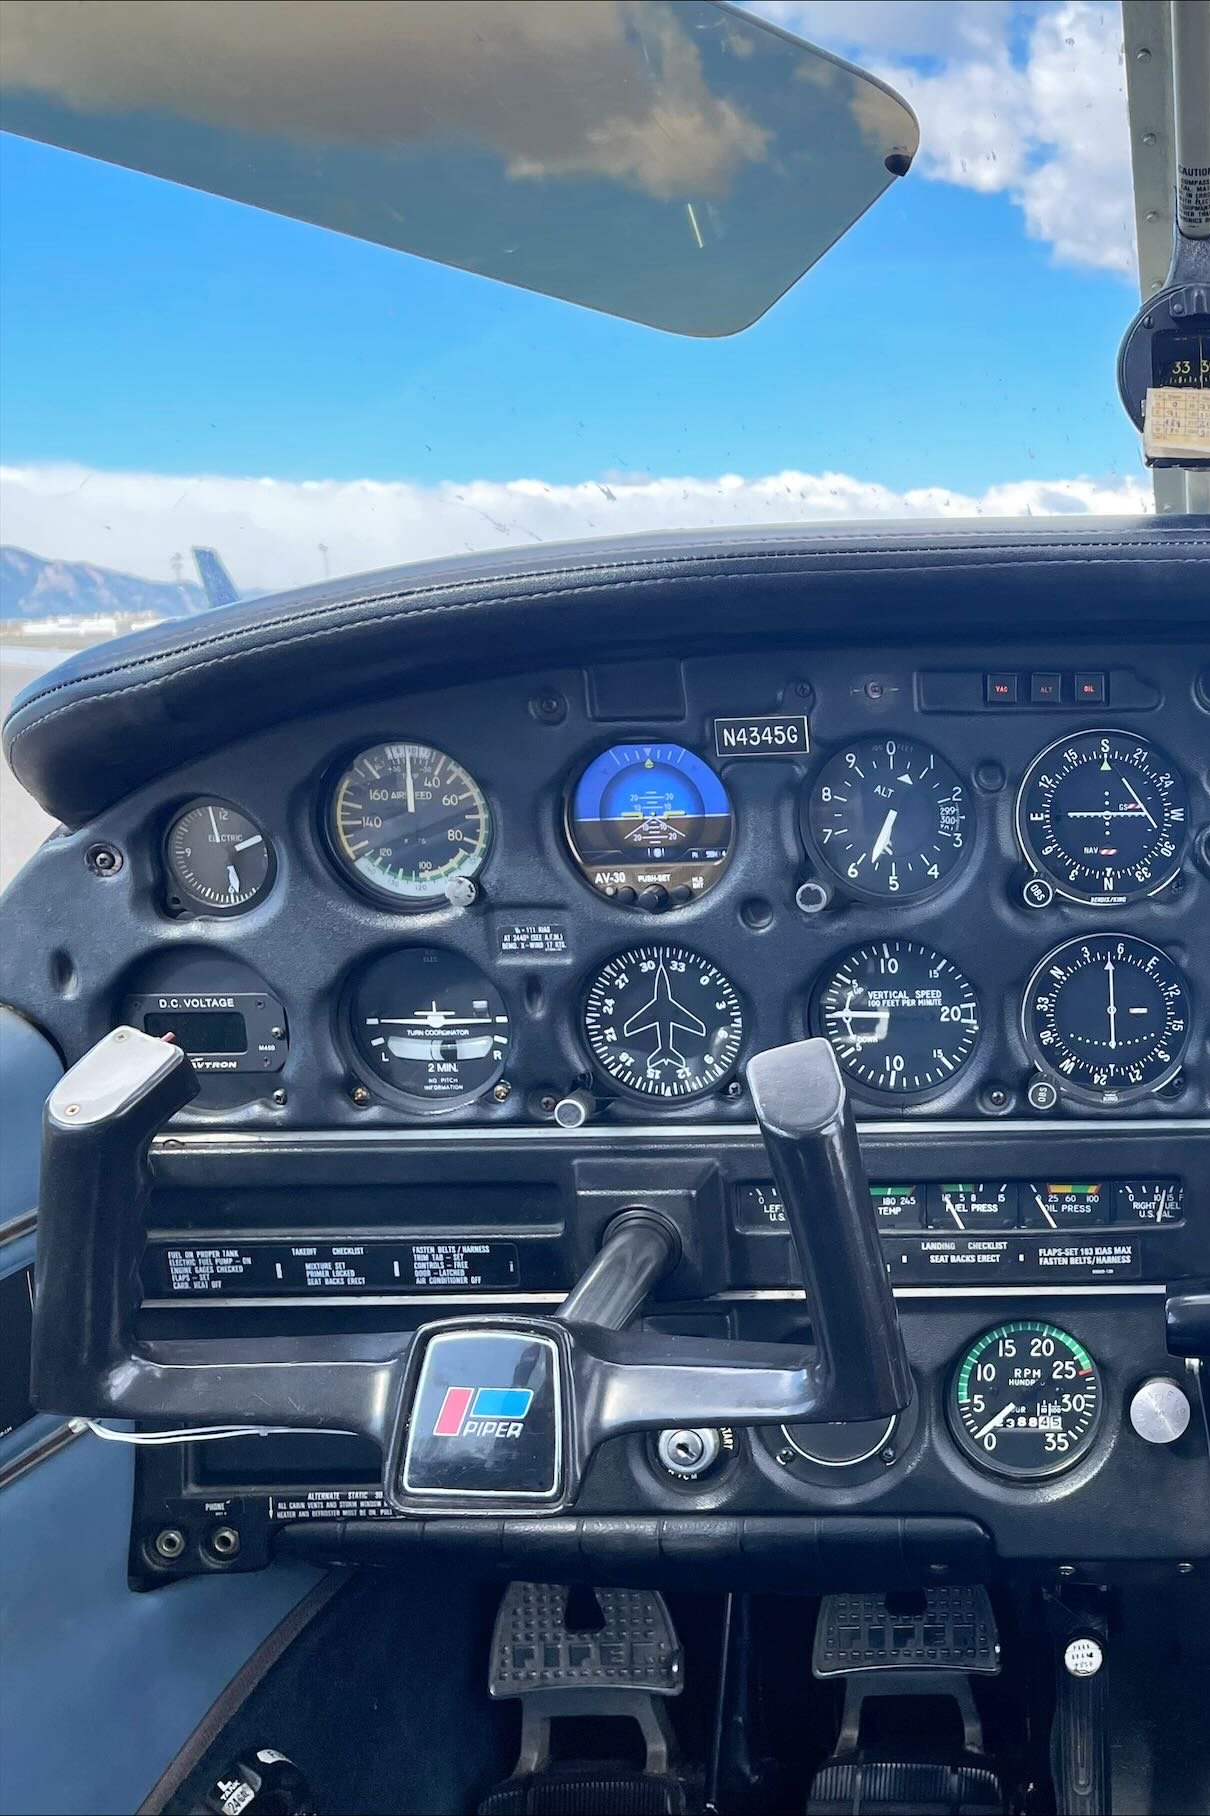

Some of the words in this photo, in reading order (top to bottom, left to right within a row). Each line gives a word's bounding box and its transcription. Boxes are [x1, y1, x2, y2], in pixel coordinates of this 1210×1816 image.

[1172, 361, 1191, 374] 33
[723, 726, 798, 747] N4345G
[886, 741, 895, 755] 0
[1101, 739, 1109, 752] S
[846, 753, 856, 768] 9
[1064, 749, 1078, 763] 15
[1133, 748, 1148, 762] 21
[424, 777, 440, 788] 40
[370, 790, 388, 800] 160
[822, 787, 832, 801] 8
[874, 785, 894, 798] ALT
[952, 787, 962, 801] 2
[442, 795, 458, 806] 60
[219, 811, 228, 820] 12
[362, 817, 382, 828] 140
[448, 830, 462, 841] 80
[822, 829, 832, 844] 7
[953, 833, 962, 848] 3
[185, 848, 191, 856] 9
[380, 848, 392, 856] 120
[848, 863, 858, 877] 6
[928, 864, 939, 878] 4
[595, 872, 625, 884] AV-30
[889, 877, 899, 891] 5
[1104, 877, 1113, 891] N
[1030, 885, 1045, 901] OBS
[1081, 946, 1090, 958] 3
[639, 960, 655, 972] 30
[670, 961, 686, 972] 33
[881, 958, 898, 974] 10
[929, 970, 939, 978] 15
[868, 990, 909, 999] VERTICAL
[915, 990, 941, 998] SPEED
[159, 999, 181, 1008] D.C.
[184, 998, 234, 1007] VOLTAGE
[868, 999, 880, 1007] 100
[940, 1007, 961, 1021] 20
[382, 1052, 389, 1062] L
[493, 1051, 502, 1060] R
[428, 1063, 435, 1072] 2
[437, 1063, 459, 1072] MIN.
[886, 1055, 904, 1071] 10
[1037, 1087, 1047, 1103] OBS
[900, 1197, 915, 1205] 245
[1048, 1194, 1059, 1202] 25
[1065, 1194, 1076, 1202] 60
[1086, 1194, 1099, 1203] 100
[878, 1207, 902, 1215] TEMP
[971, 1204, 999, 1212] PRESS
[1061, 1205, 1092, 1213] PRESS
[1133, 1202, 1155, 1210] RIGHT
[968, 1242, 1007, 1250] CHECKLIST
[1039, 1248, 1078, 1256] FLAPS-SET
[1095, 1247, 1112, 1255] KIAS
[1114, 1246, 1132, 1255] MAX
[1039, 1257, 1067, 1265] FASTEN
[1069, 1255, 1131, 1264] BELTS/HARNESS
[999, 1339, 1016, 1357] 15
[1030, 1338, 1054, 1357] 20
[977, 1364, 995, 1381] 10
[1014, 1369, 1041, 1378] RPM
[1052, 1361, 1076, 1379] 25
[973, 1395, 985, 1412] 5
[1062, 1394, 1085, 1412] 30
[463, 1421, 524, 1438] PIPER
[984, 1433, 996, 1450] 0
[1045, 1433, 1069, 1451] 35
[205, 1502, 225, 1511] PHONE
